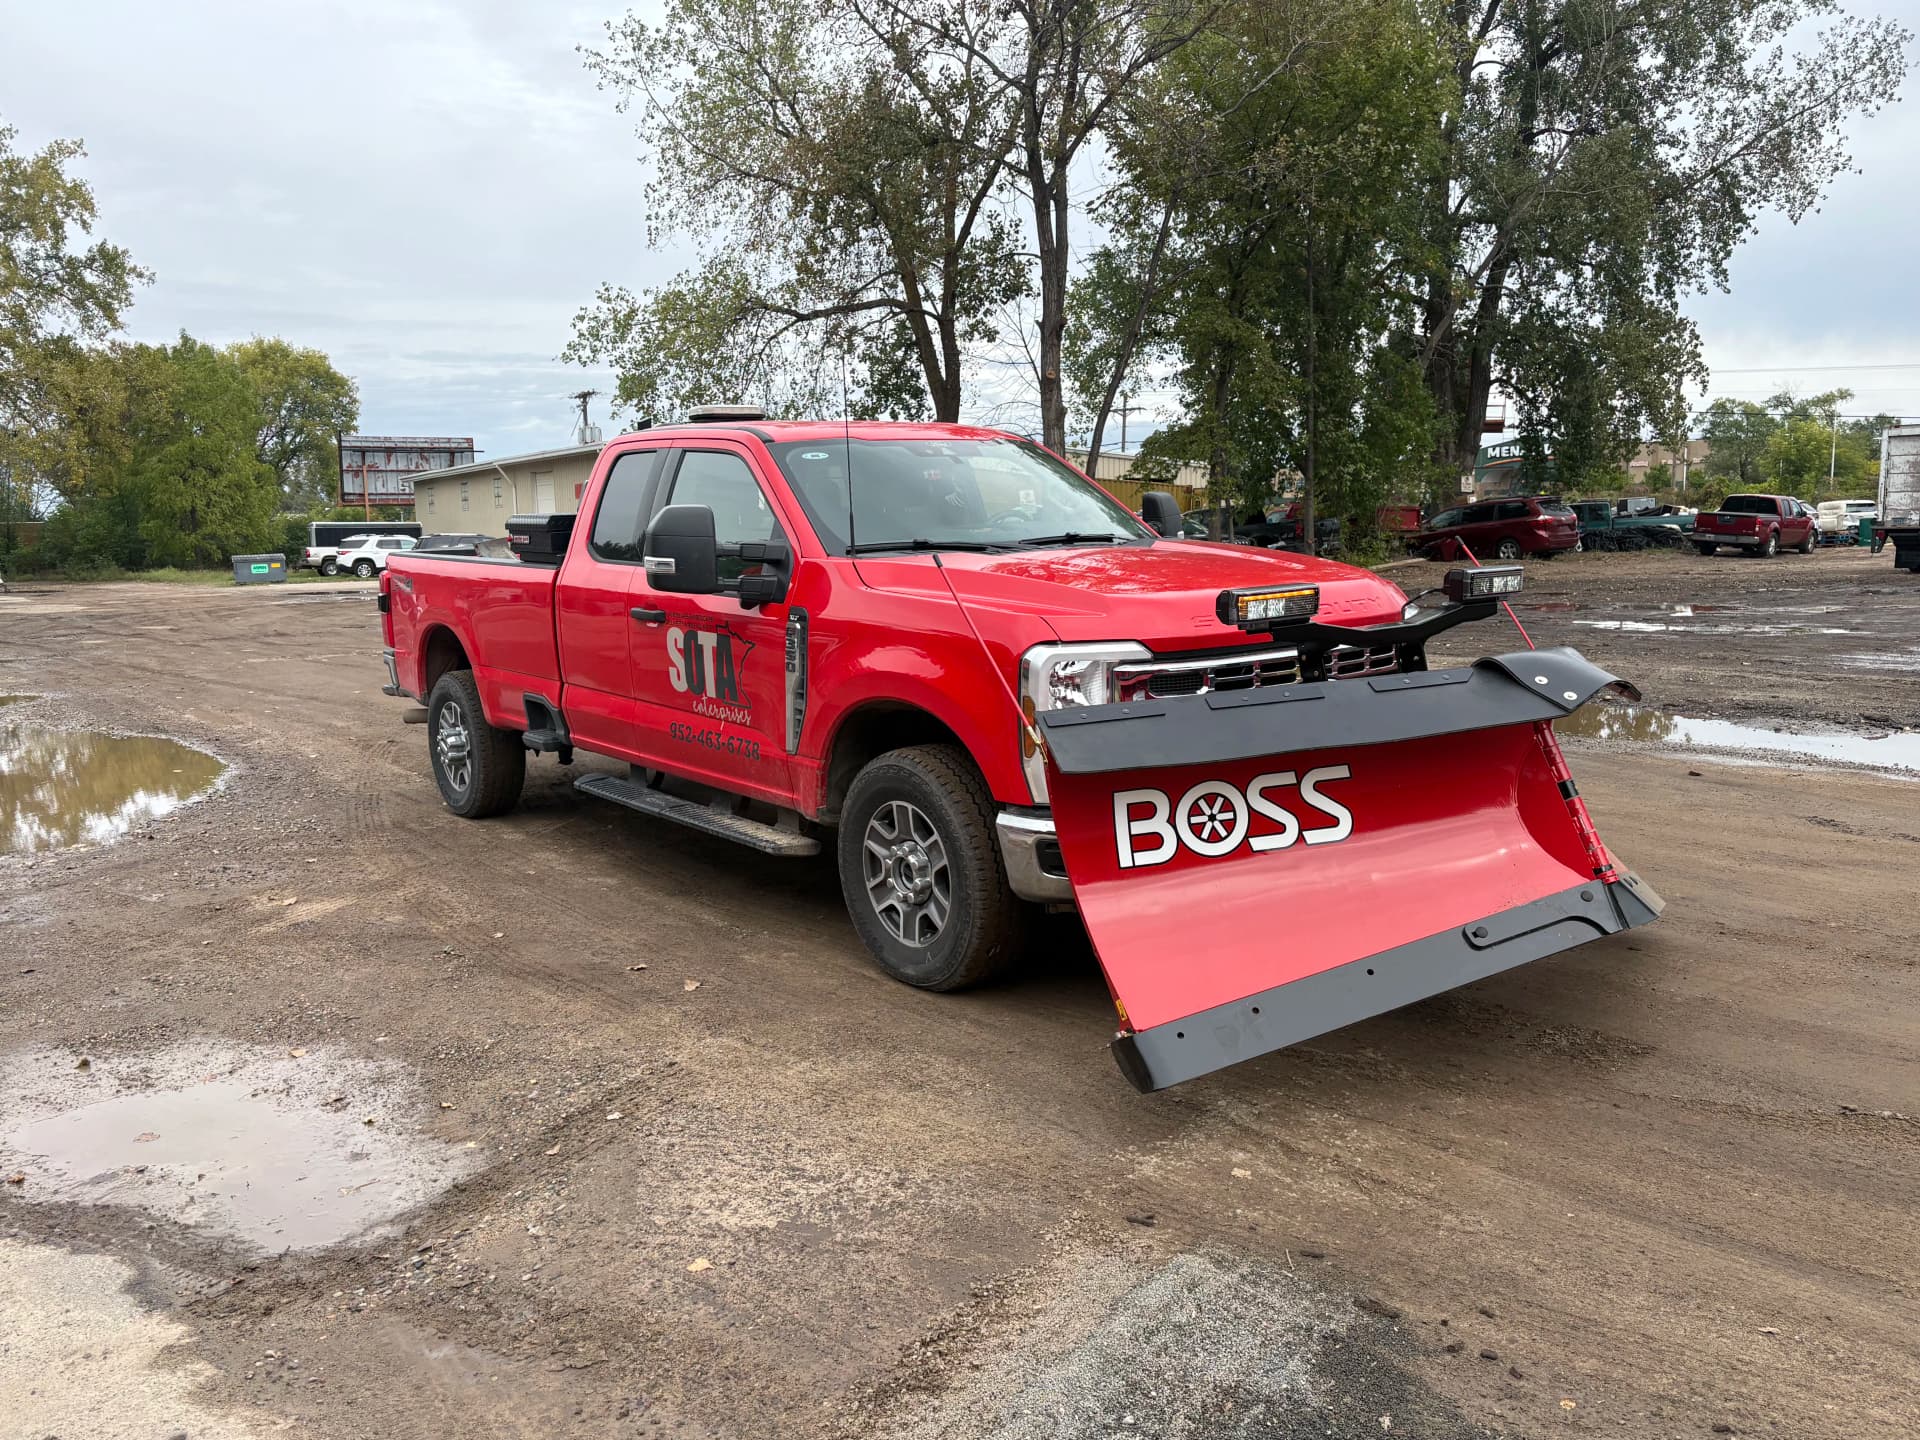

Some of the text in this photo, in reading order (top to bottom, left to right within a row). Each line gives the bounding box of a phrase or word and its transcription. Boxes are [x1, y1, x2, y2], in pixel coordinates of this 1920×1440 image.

[666, 627, 739, 704] SOTA
[692, 693, 751, 731] enterprises
[670, 722, 761, 761] 952-463-6738
[1113, 764, 1354, 869] BOSS
